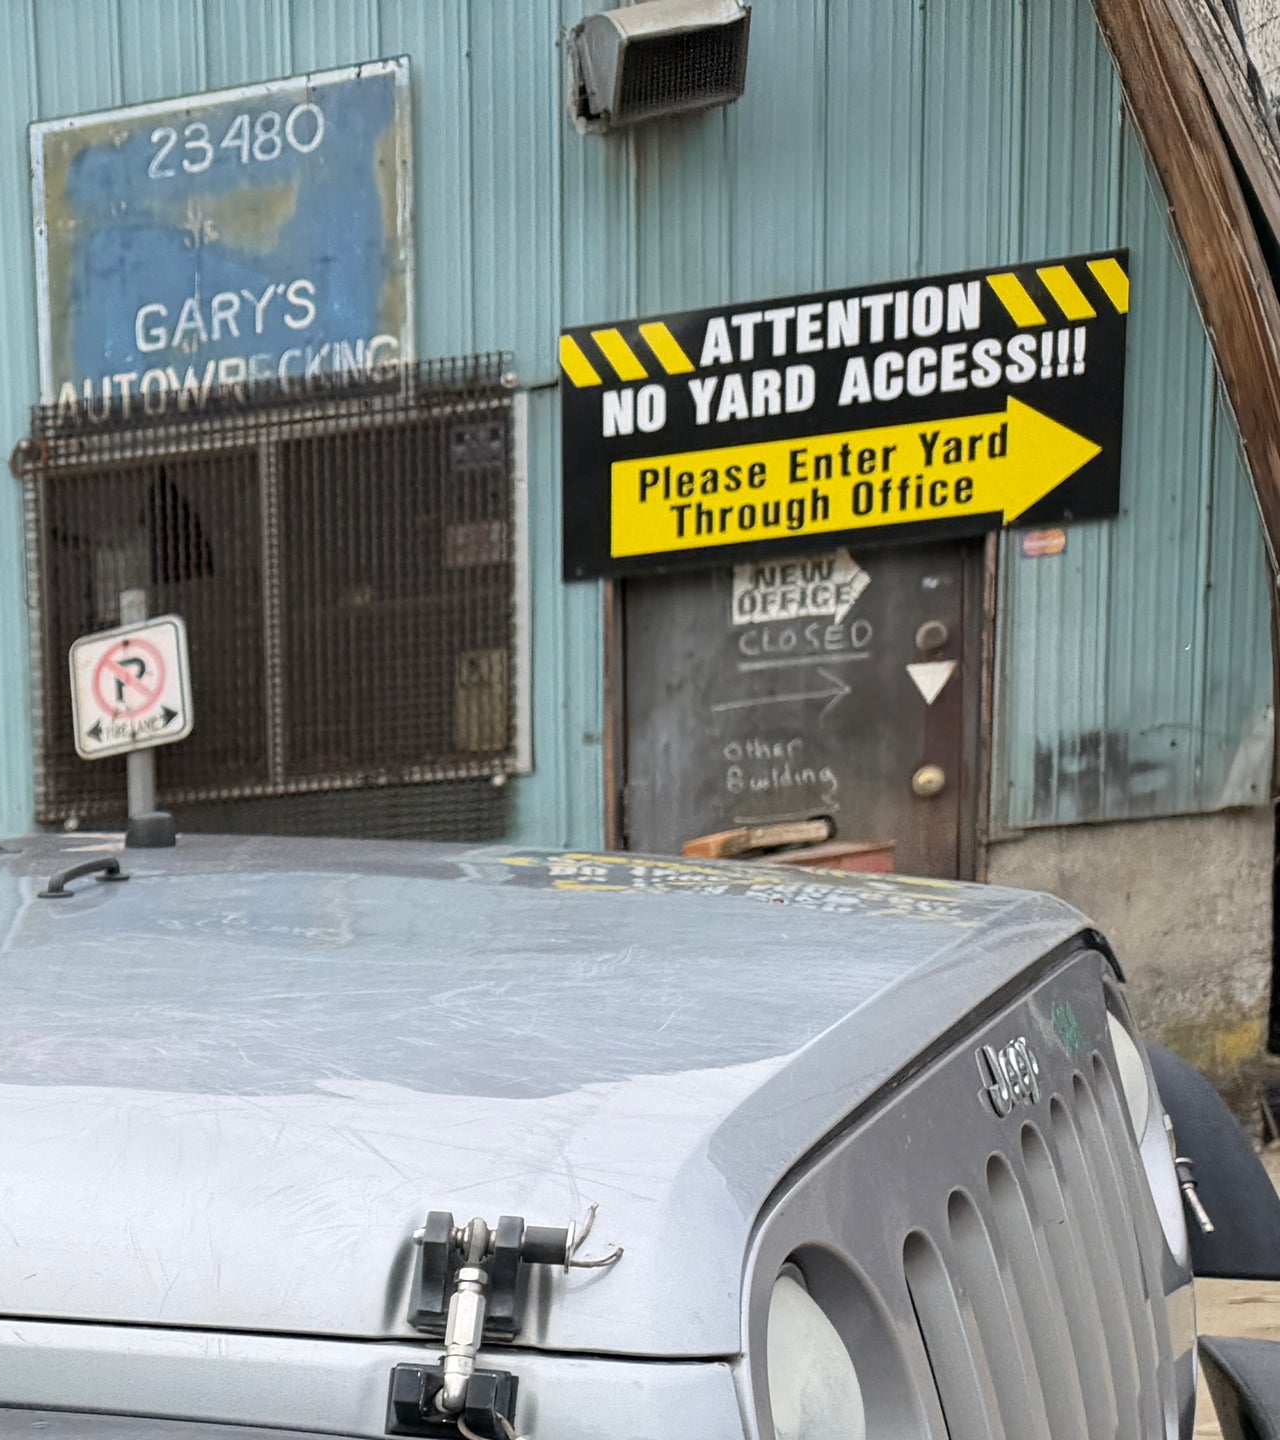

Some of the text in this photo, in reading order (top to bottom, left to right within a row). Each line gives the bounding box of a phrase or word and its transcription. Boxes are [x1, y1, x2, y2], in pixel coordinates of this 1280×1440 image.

[147, 102, 326, 179] 23480
[135, 279, 317, 353] GARY'S
[699, 280, 981, 367] ATTENTION
[55, 333, 401, 428] AUTOWRECKING
[601, 326, 1087, 438] NO YARD ACCESS!!!
[638, 422, 1009, 503] Please Enter Yard
[671, 475, 975, 541] Through Office
[738, 583, 857, 617] OFFICE
[753, 559, 837, 589] NEW
[739, 619, 873, 656] CLOSED
[722, 736, 803, 763] Other
